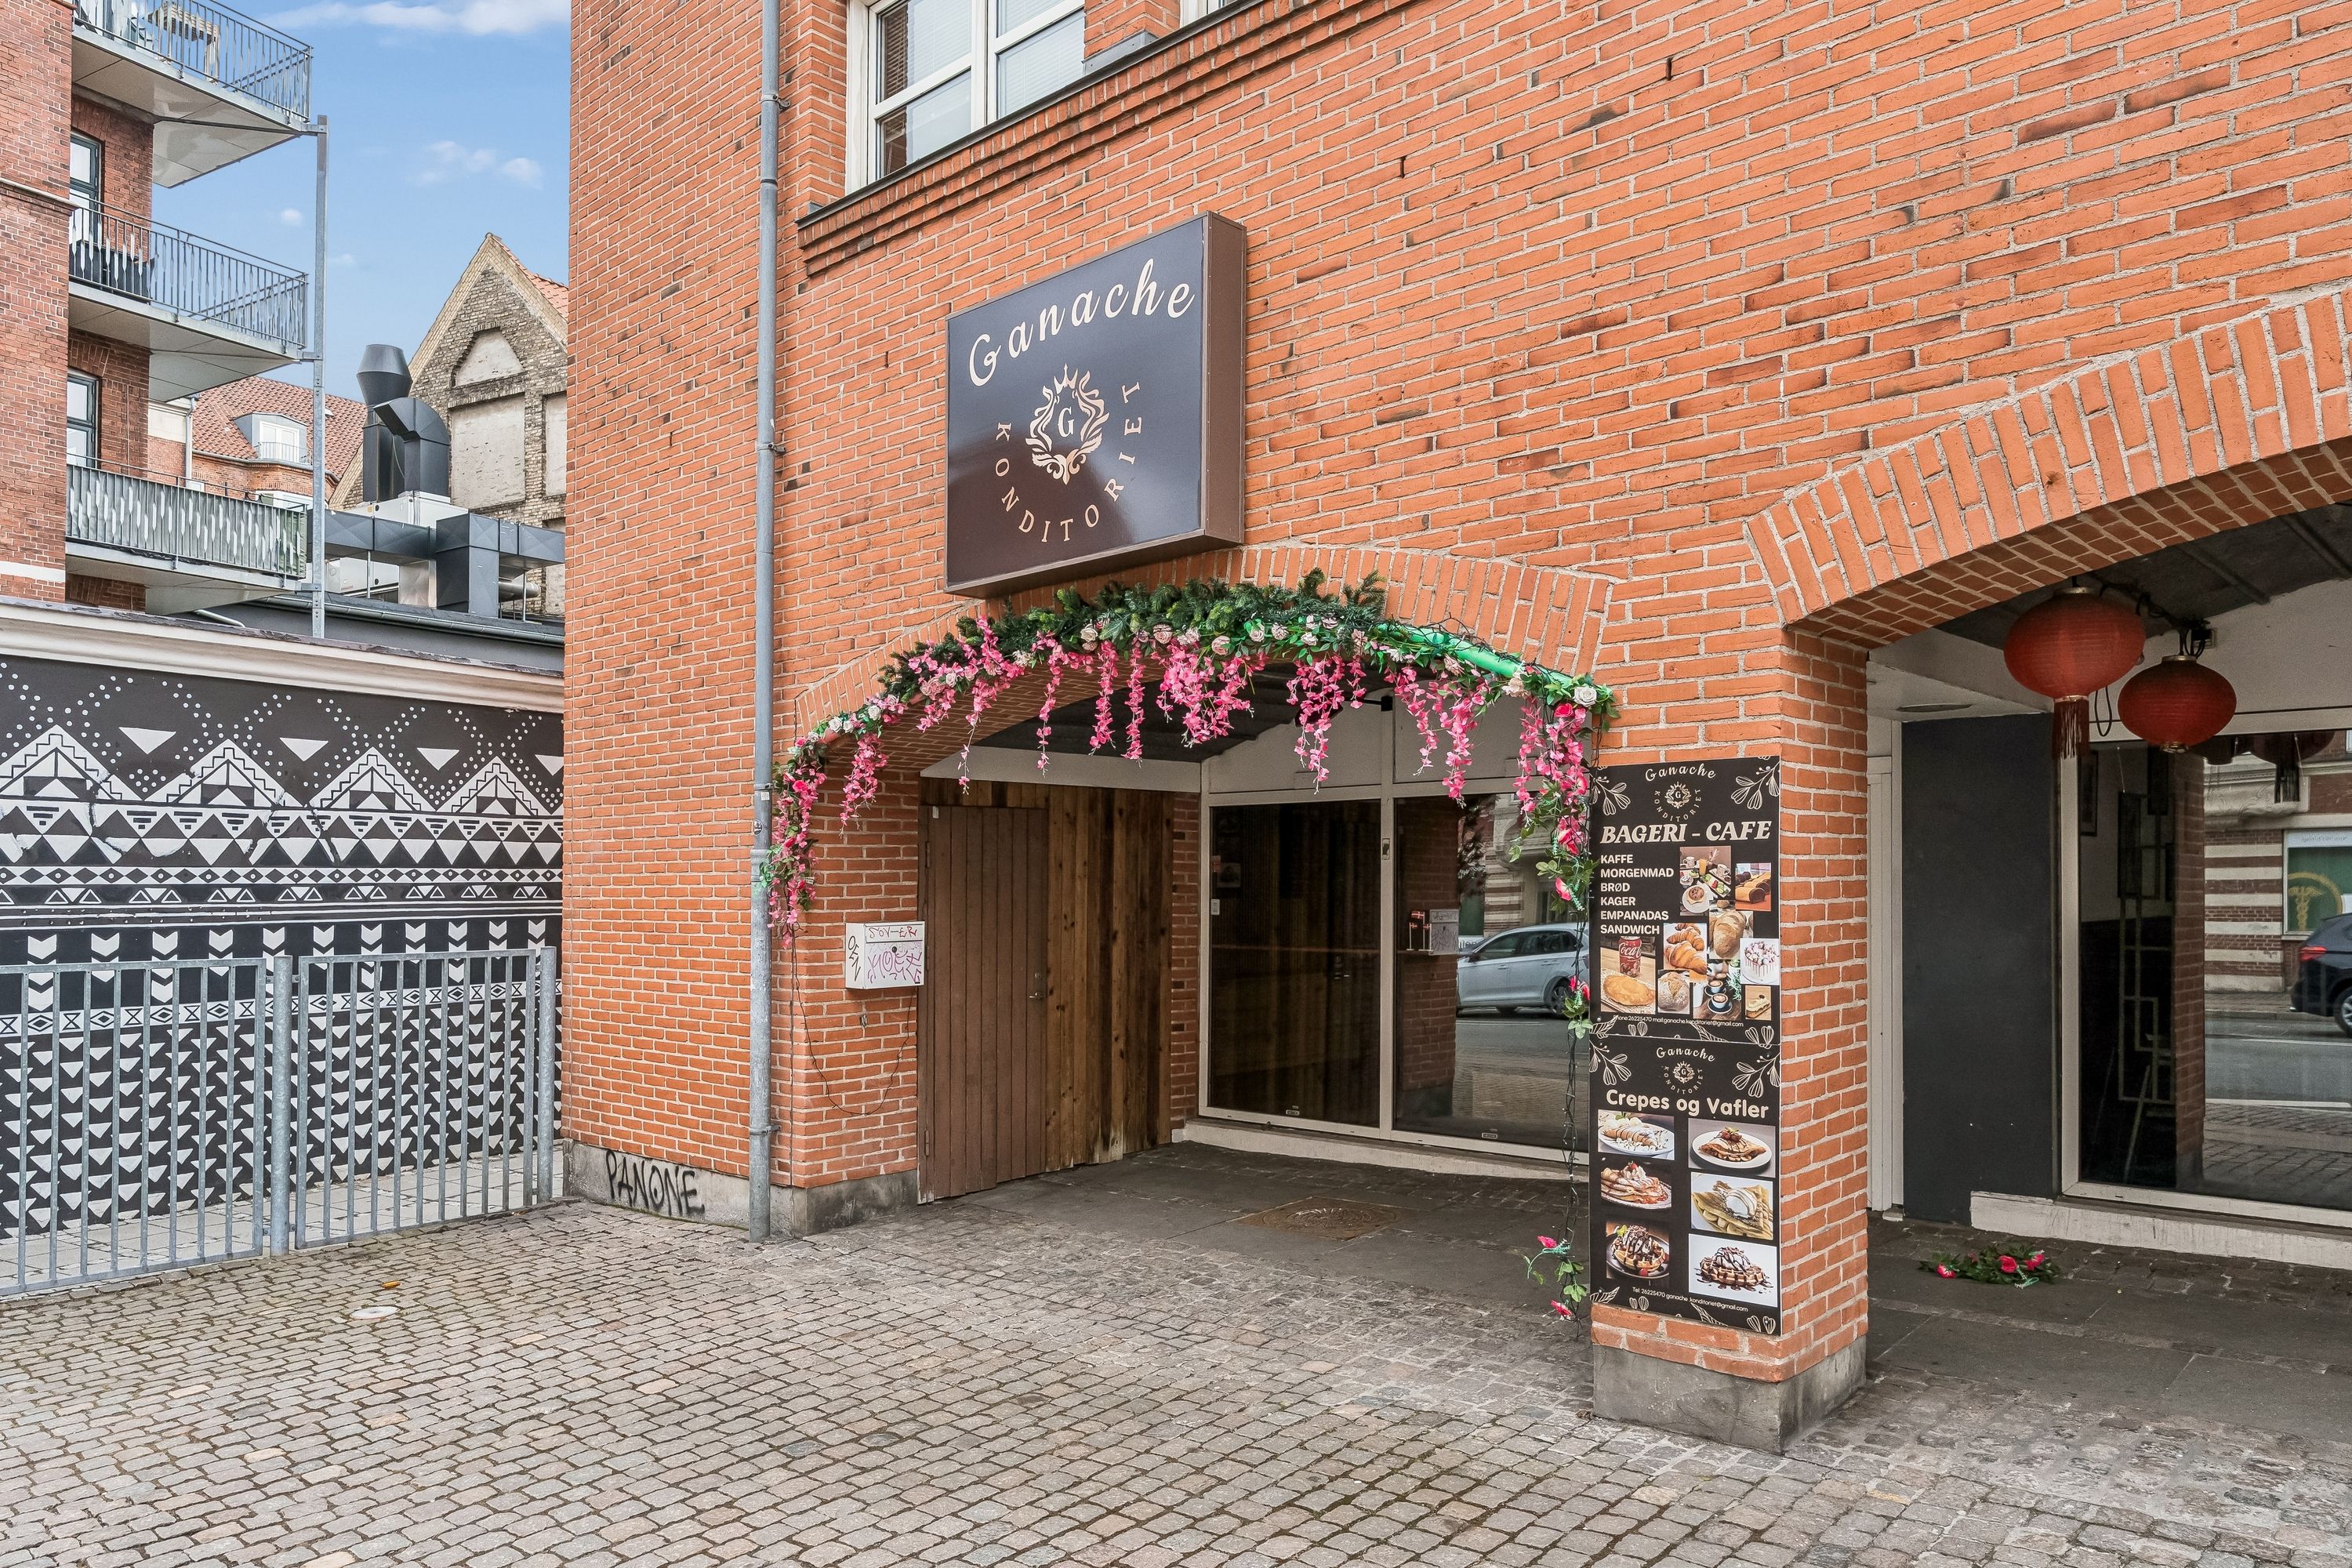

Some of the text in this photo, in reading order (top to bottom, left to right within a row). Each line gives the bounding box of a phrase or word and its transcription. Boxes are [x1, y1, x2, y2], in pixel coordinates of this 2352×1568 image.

[969, 258, 1196, 387] Ganache
[1057, 406, 1075, 437] G
[995, 381, 1143, 543] KONDITORIET
[1645, 763, 1716, 782] Ganache
[1654, 789, 1701, 822] KONDITORIET
[1599, 823, 1688, 844] BAGERI
[1706, 821, 1772, 841] CAFE
[1600, 854, 1634, 864] KAFFE
[1600, 868, 1675, 878] MORGENMAD
[1600, 882, 1631, 892] BRØD
[1600, 897, 1636, 906] KAGER
[1600, 910, 1669, 920] EMPANADAS
[1600, 924, 1661, 935] SANDWICH
[1656, 1047, 1715, 1062] Ganache
[1664, 1065, 1703, 1094] KONDITORIET
[1606, 1089, 1769, 1119] Crepes og Vafler
[606, 1150, 706, 1217] PANONE
[1641, 1289, 1666, 1298] 26225470
